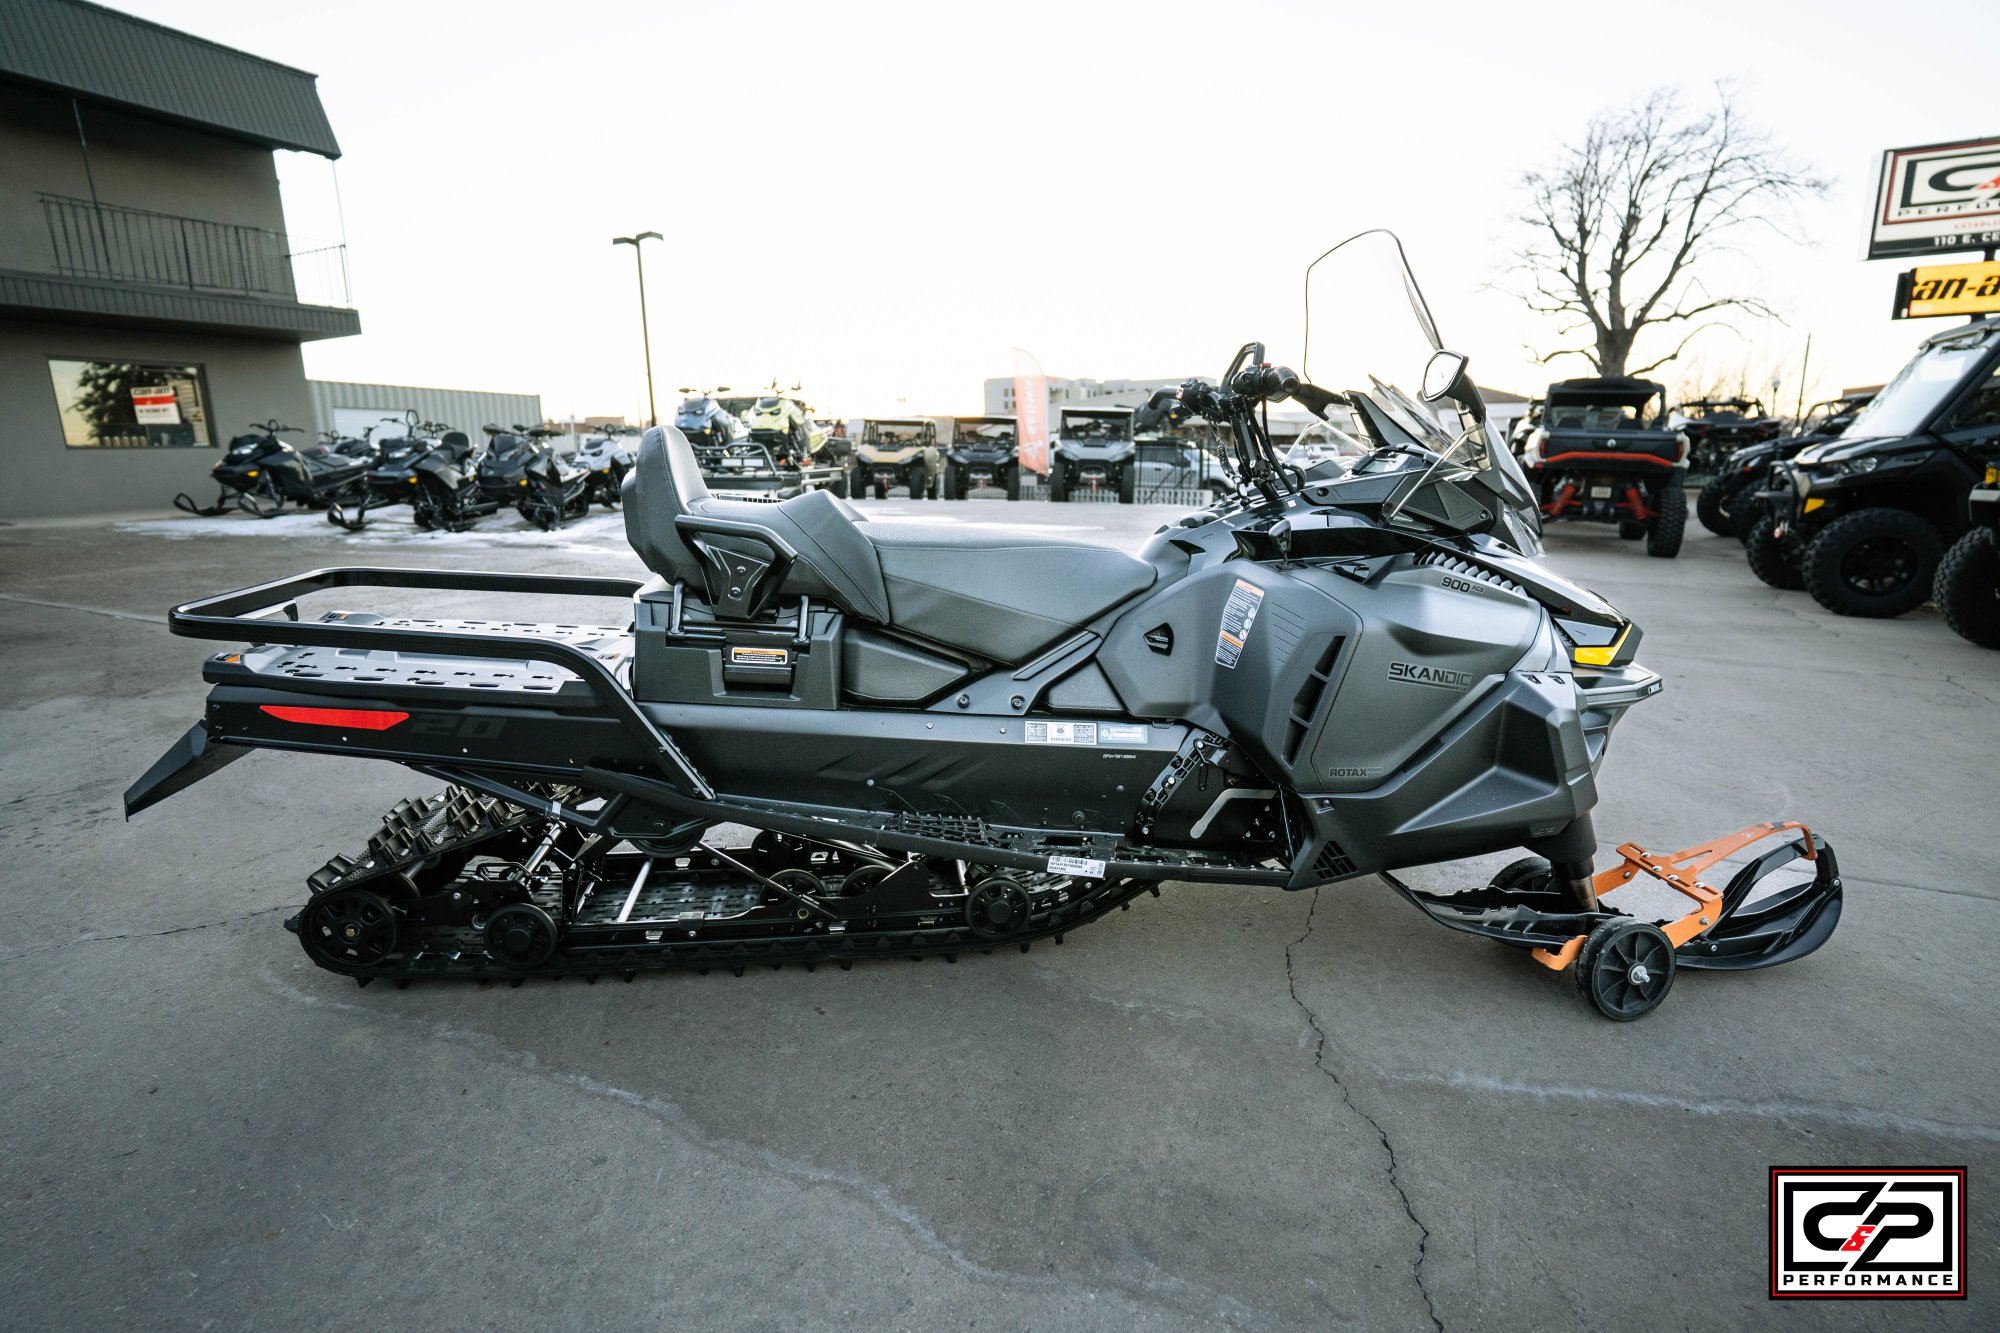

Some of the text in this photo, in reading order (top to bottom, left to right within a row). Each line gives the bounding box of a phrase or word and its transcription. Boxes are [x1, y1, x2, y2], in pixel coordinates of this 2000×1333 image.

[1898, 199, 2000, 216] PERFO
[1934, 235, 1957, 246] 110
[1441, 576, 1470, 593] 900
[1389, 662, 1472, 686] SKANDIC
[1329, 768, 1367, 777] ROTAX
